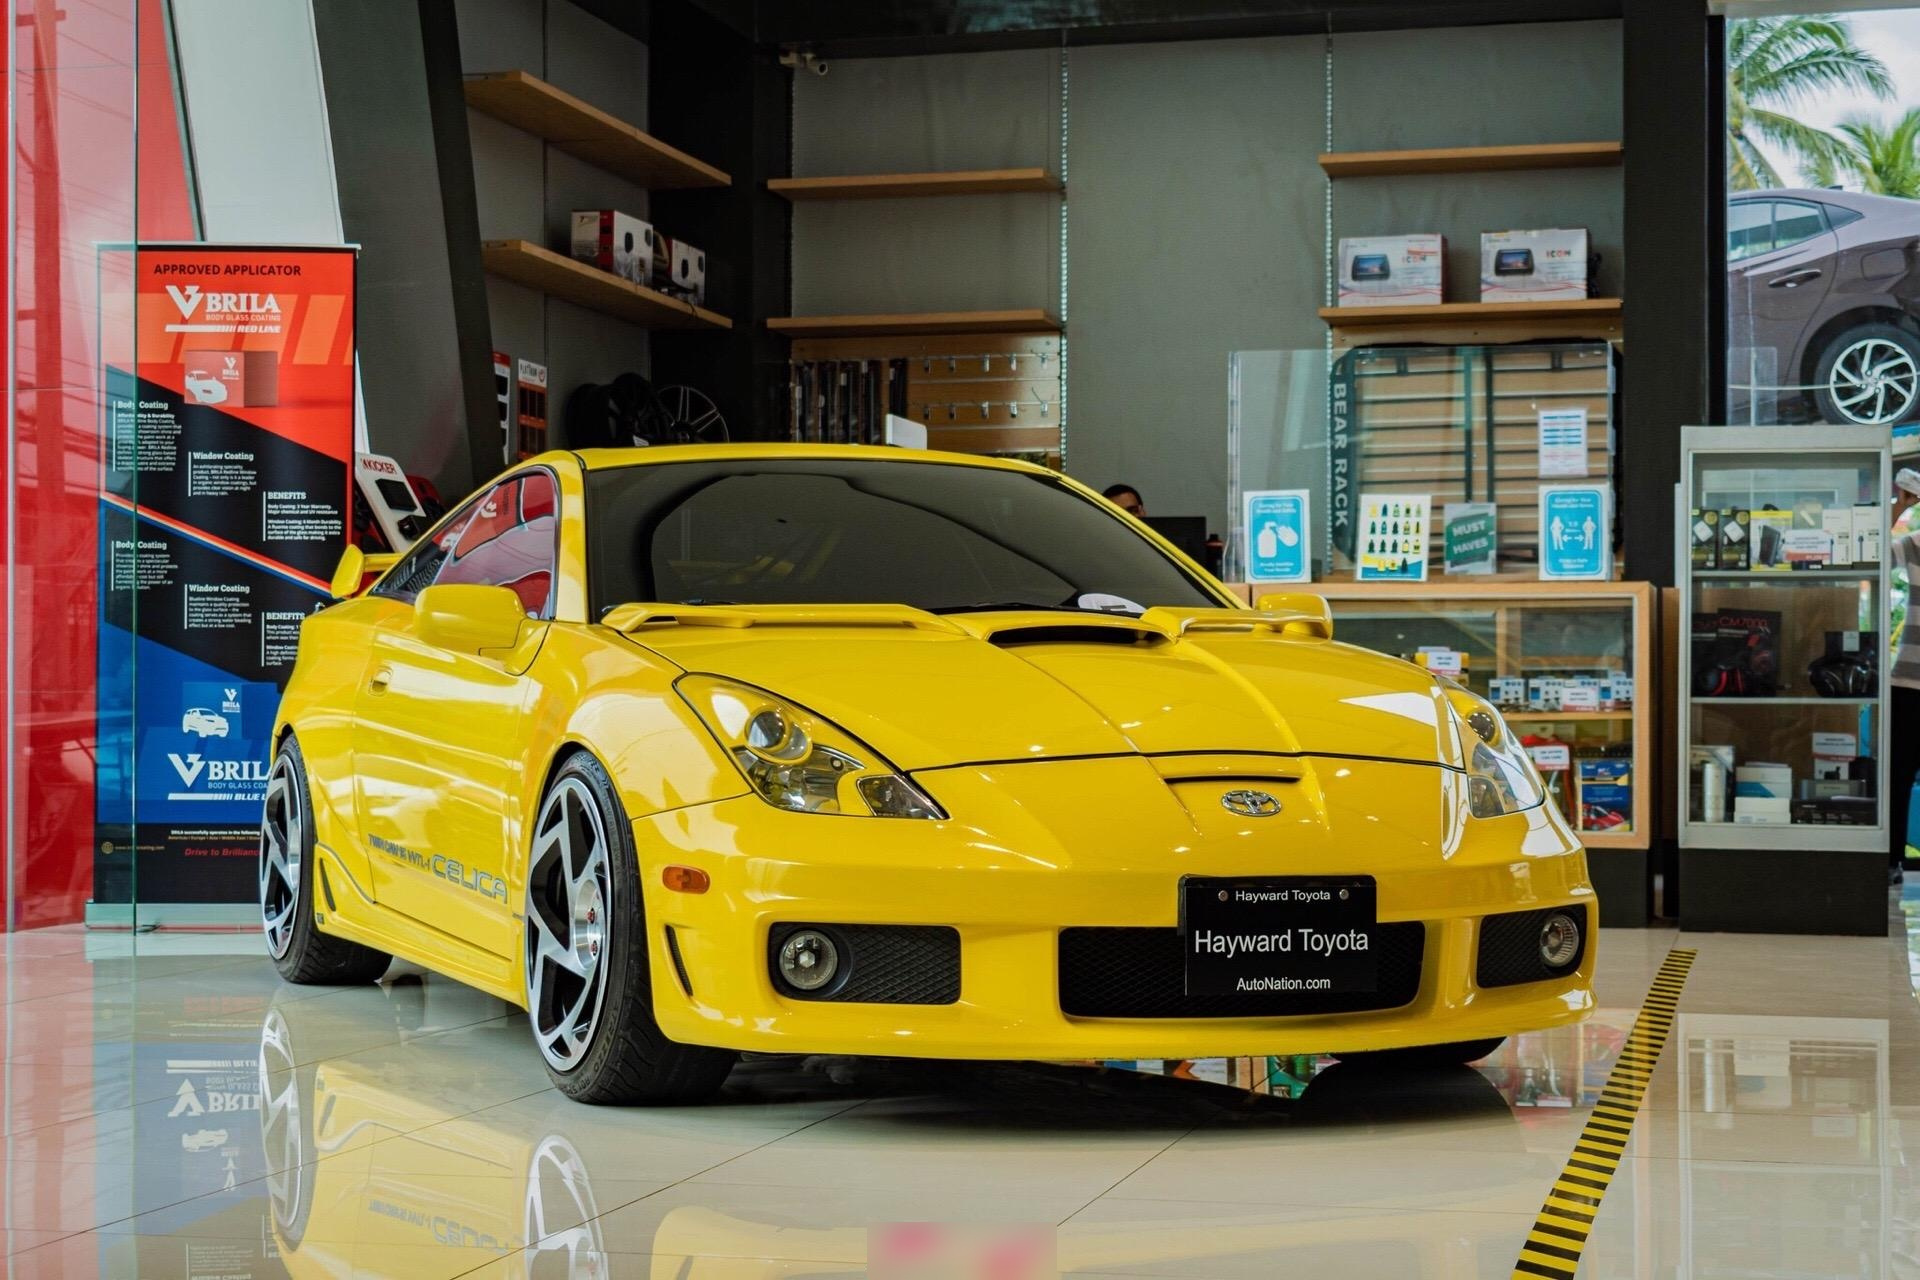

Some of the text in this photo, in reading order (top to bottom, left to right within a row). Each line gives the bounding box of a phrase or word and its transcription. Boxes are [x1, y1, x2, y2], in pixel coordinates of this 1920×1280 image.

[154, 264, 301, 276] APPROVED APPLICATOR
[206, 293, 281, 313] BRILA
[139, 401, 168, 410] Coating
[193, 452, 254, 461] Window Coating
[1333, 383, 1349, 527] BEAR RACK
[267, 491, 307, 500] BENEFITS
[1452, 520, 1486, 537] MUST
[138, 541, 167, 550] Coating
[1453, 537, 1489, 555] HAVES
[189, 584, 250, 594] Window Coating
[266, 612, 306, 620] BENEFITS
[208, 761, 271, 781] BRIL
[185, 848, 208, 856] Drive
[211, 848, 220, 856] to
[431, 854, 507, 904] CELICA
[1235, 889, 1331, 903] Hayward Toyota
[1195, 928, 1368, 958] Hayward Toyota
[1236, 977, 1331, 991] AutoNation.com
